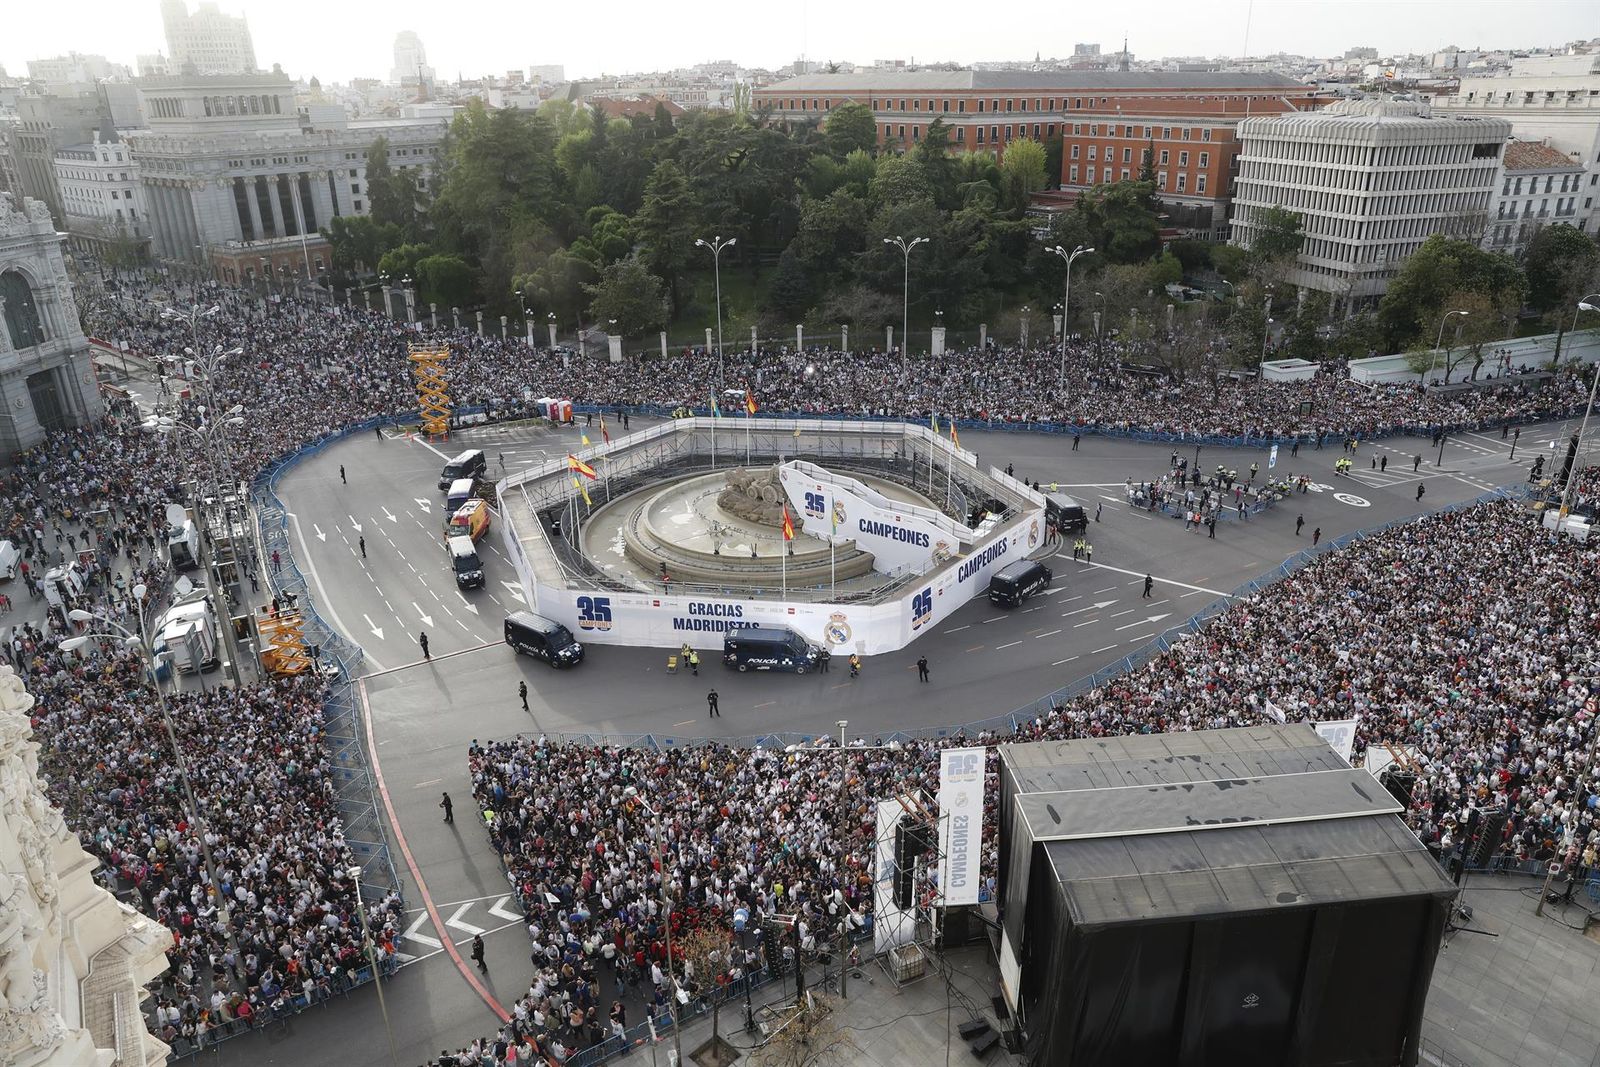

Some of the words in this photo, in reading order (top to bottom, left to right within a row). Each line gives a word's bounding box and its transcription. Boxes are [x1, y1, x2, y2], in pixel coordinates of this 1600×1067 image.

[805, 492, 825, 519] 35
[859, 518, 930, 548] CAMPEONES
[958, 537, 1008, 583] CAMPEONES
[577, 596, 612, 631] 35
[688, 602, 743, 618] GRACIAS
[912, 587, 932, 630] 35
